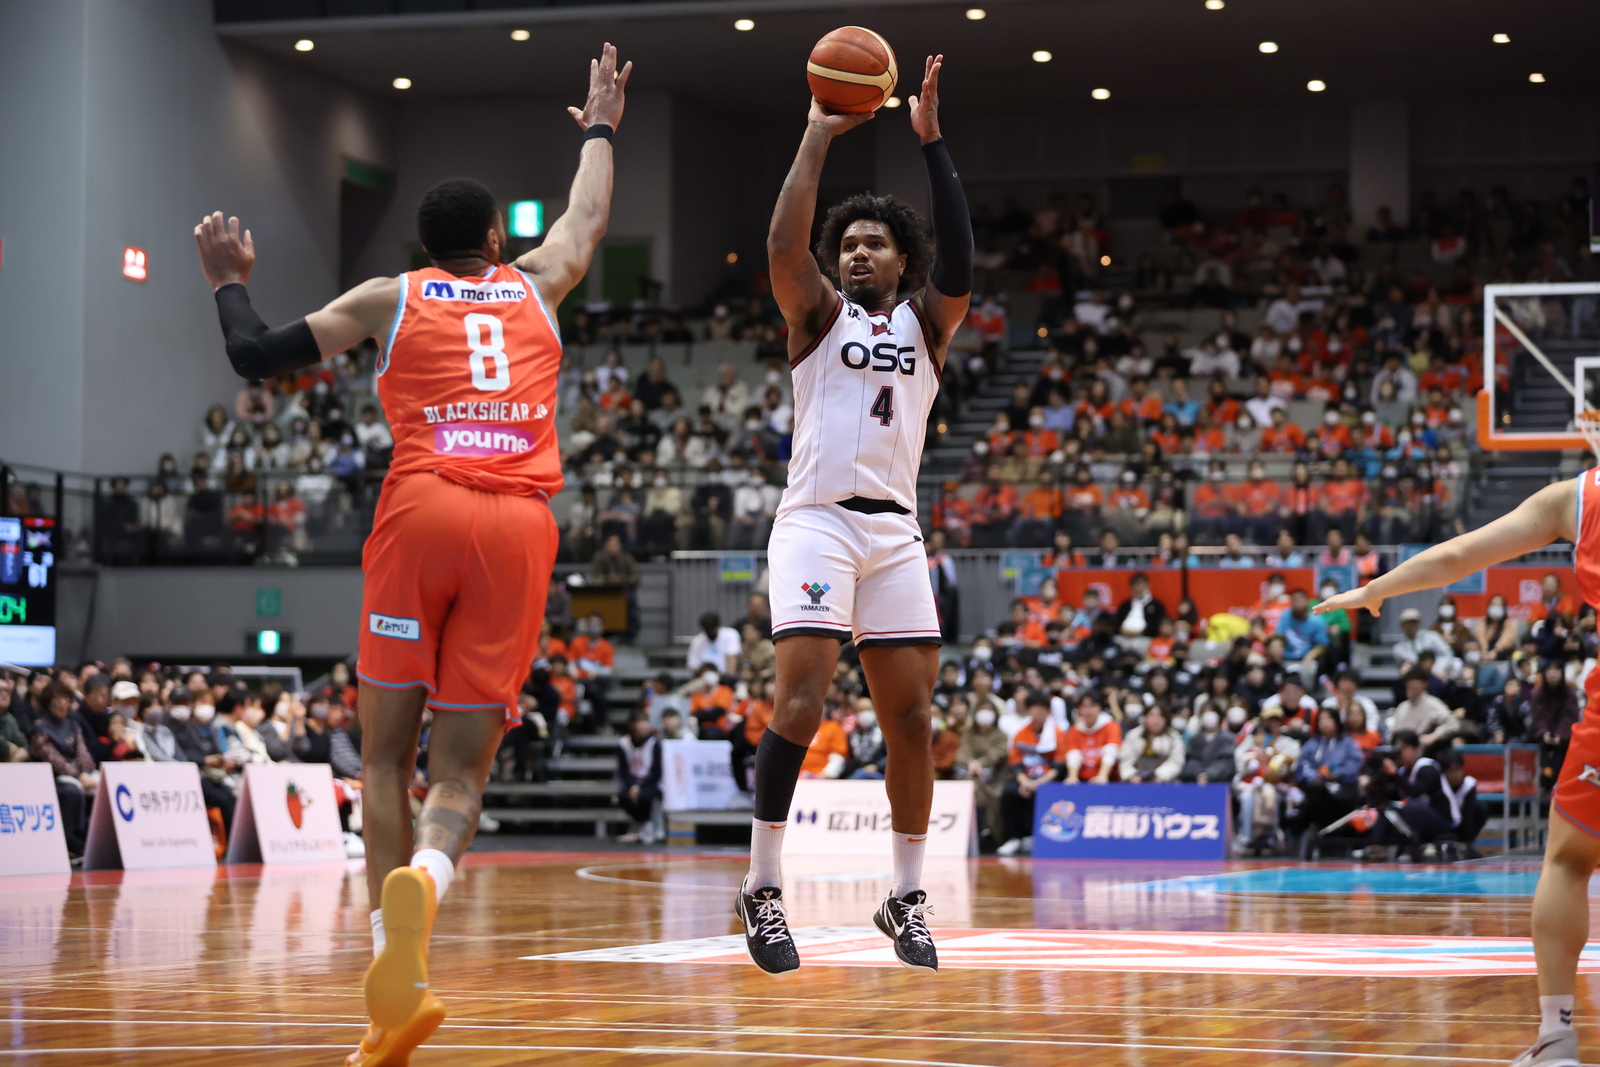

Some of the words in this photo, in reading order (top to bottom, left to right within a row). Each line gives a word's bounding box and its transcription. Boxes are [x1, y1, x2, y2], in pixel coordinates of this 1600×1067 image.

[464, 312, 511, 391] 8
[841, 341, 916, 376] OSG
[423, 402, 530, 423] BLACKSHEAR
[870, 386, 894, 427] 4
